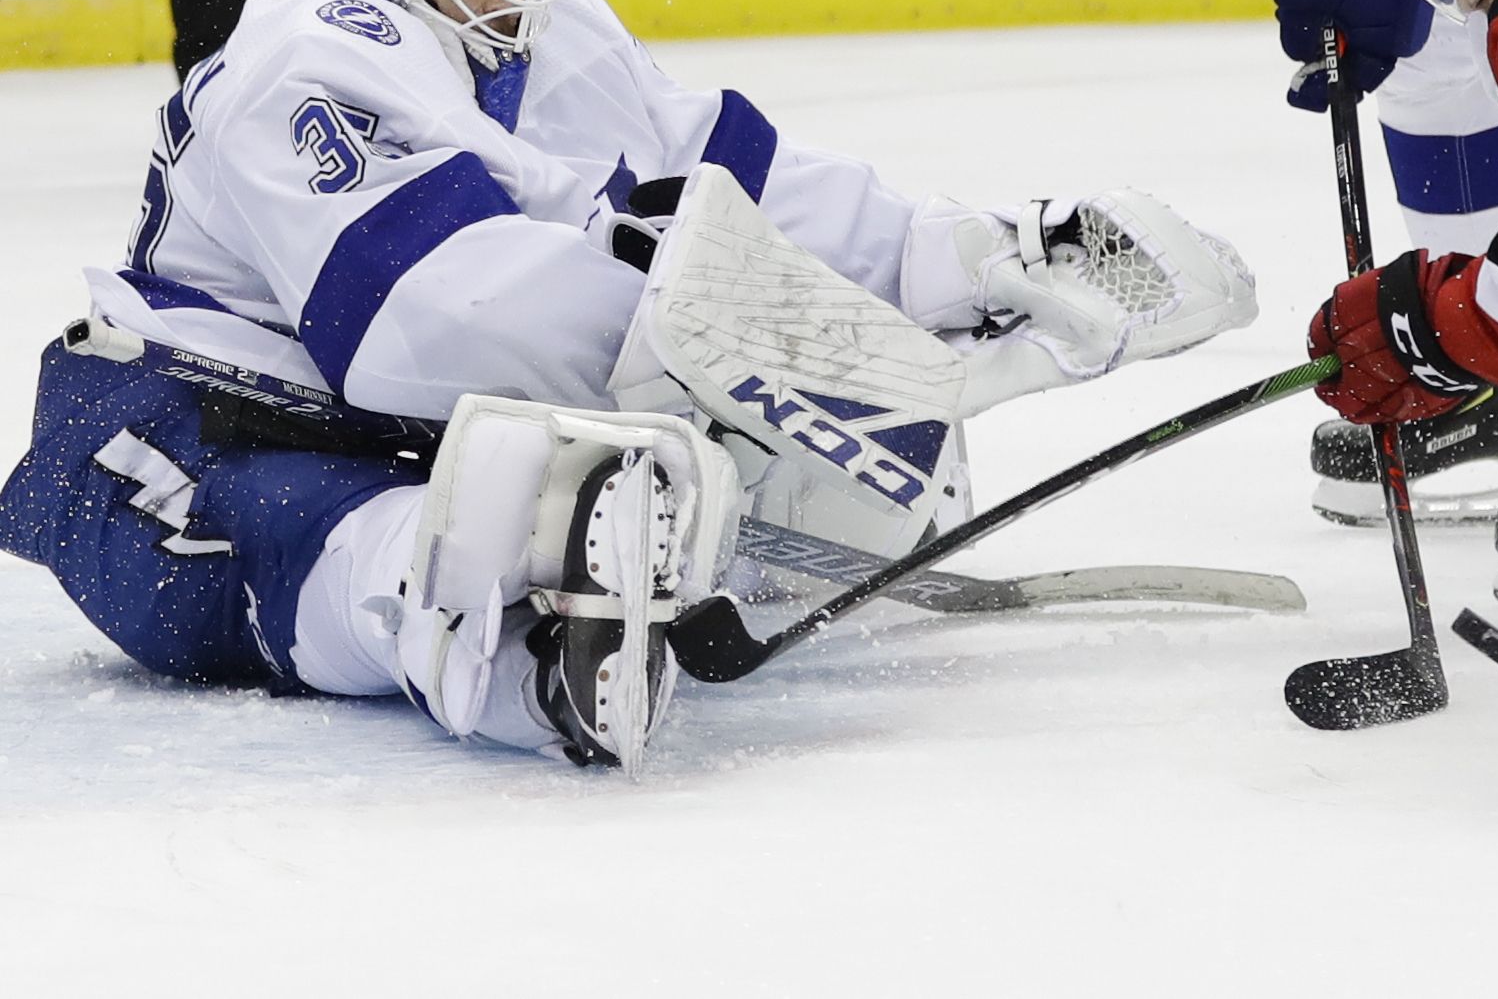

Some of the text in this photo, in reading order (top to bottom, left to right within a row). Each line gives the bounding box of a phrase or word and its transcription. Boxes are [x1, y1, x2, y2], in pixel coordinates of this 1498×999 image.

[171, 348, 236, 377] SUPREME
[155, 365, 293, 408] SUPREME
[727, 374, 926, 514] CCM
